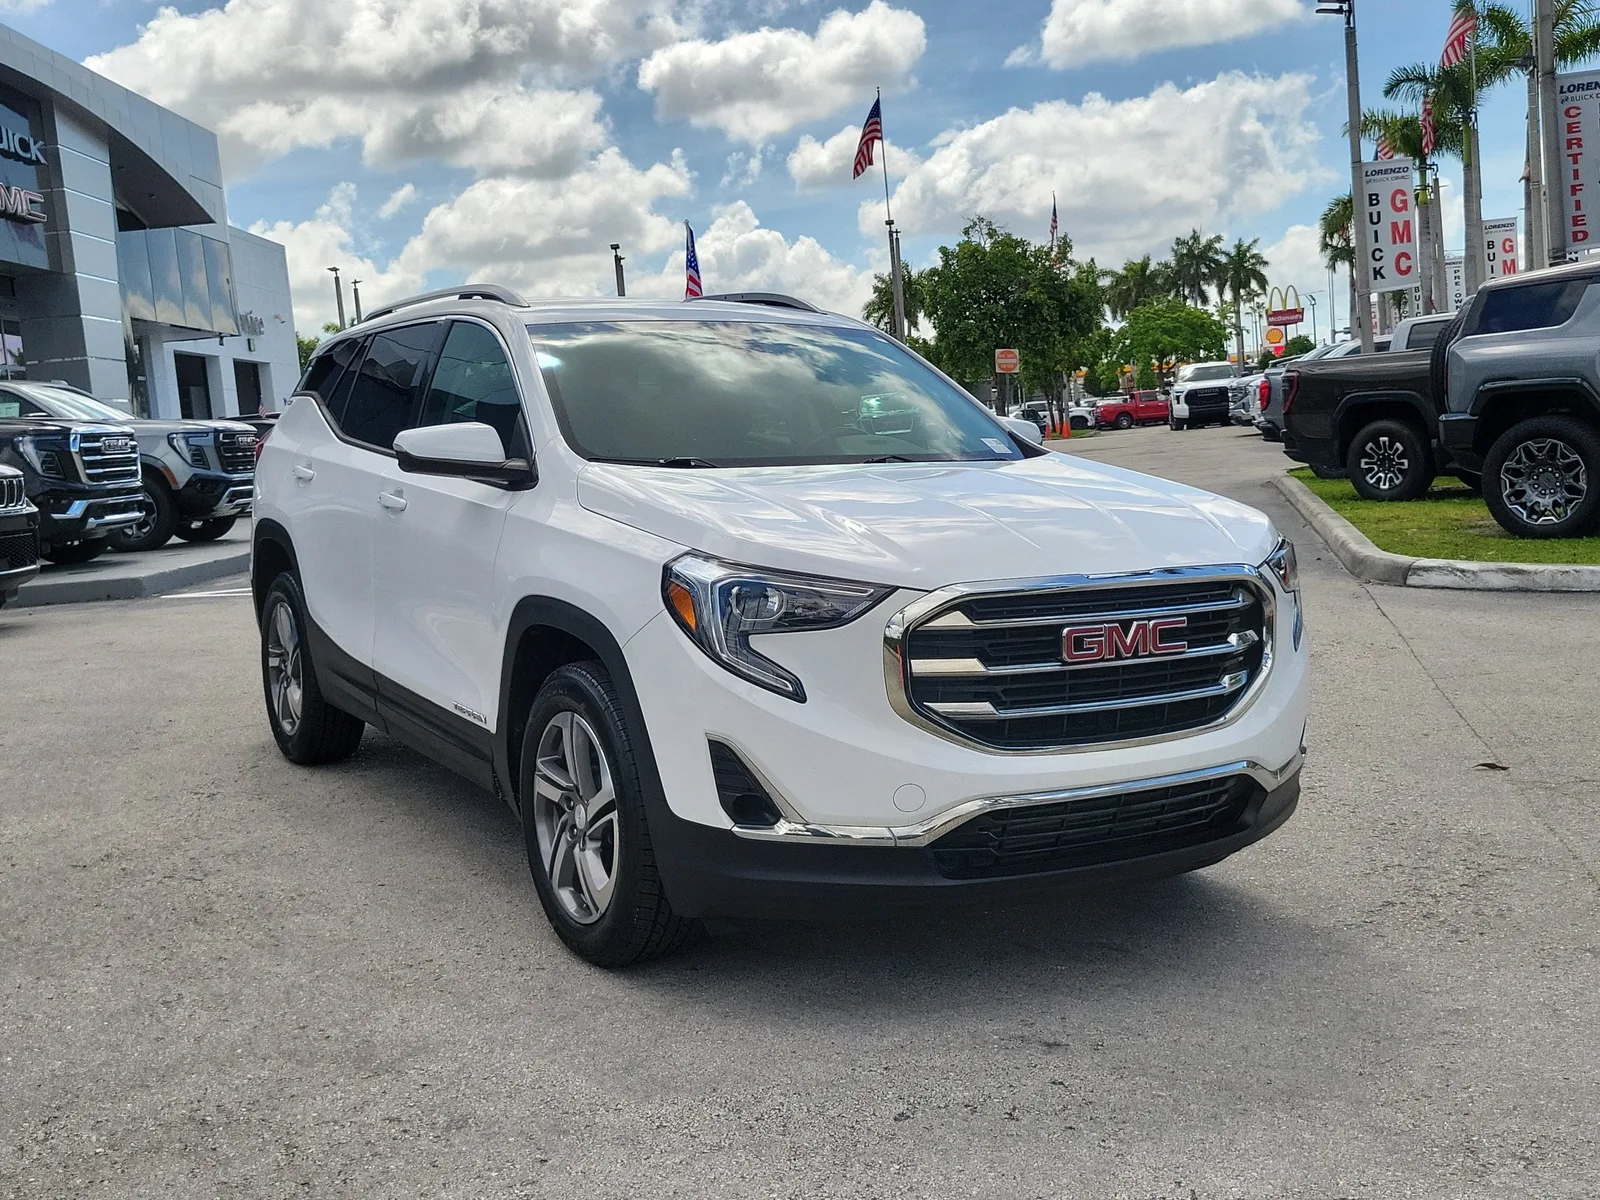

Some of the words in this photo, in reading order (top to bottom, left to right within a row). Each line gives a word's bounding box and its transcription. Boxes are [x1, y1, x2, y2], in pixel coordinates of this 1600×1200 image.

[1570, 93, 1595, 102] BUICK
[1365, 166, 1409, 177] LORENZO
[1564, 105, 1589, 243] CERTIFIED
[1368, 192, 1386, 280] BUICK
[1390, 189, 1412, 276] GMC
[1485, 222, 1515, 230] LORENZO
[1487, 240, 1496, 279] BUI
[1269, 314, 1302, 322] McDonald's
[1062, 616, 1188, 662] GMC
